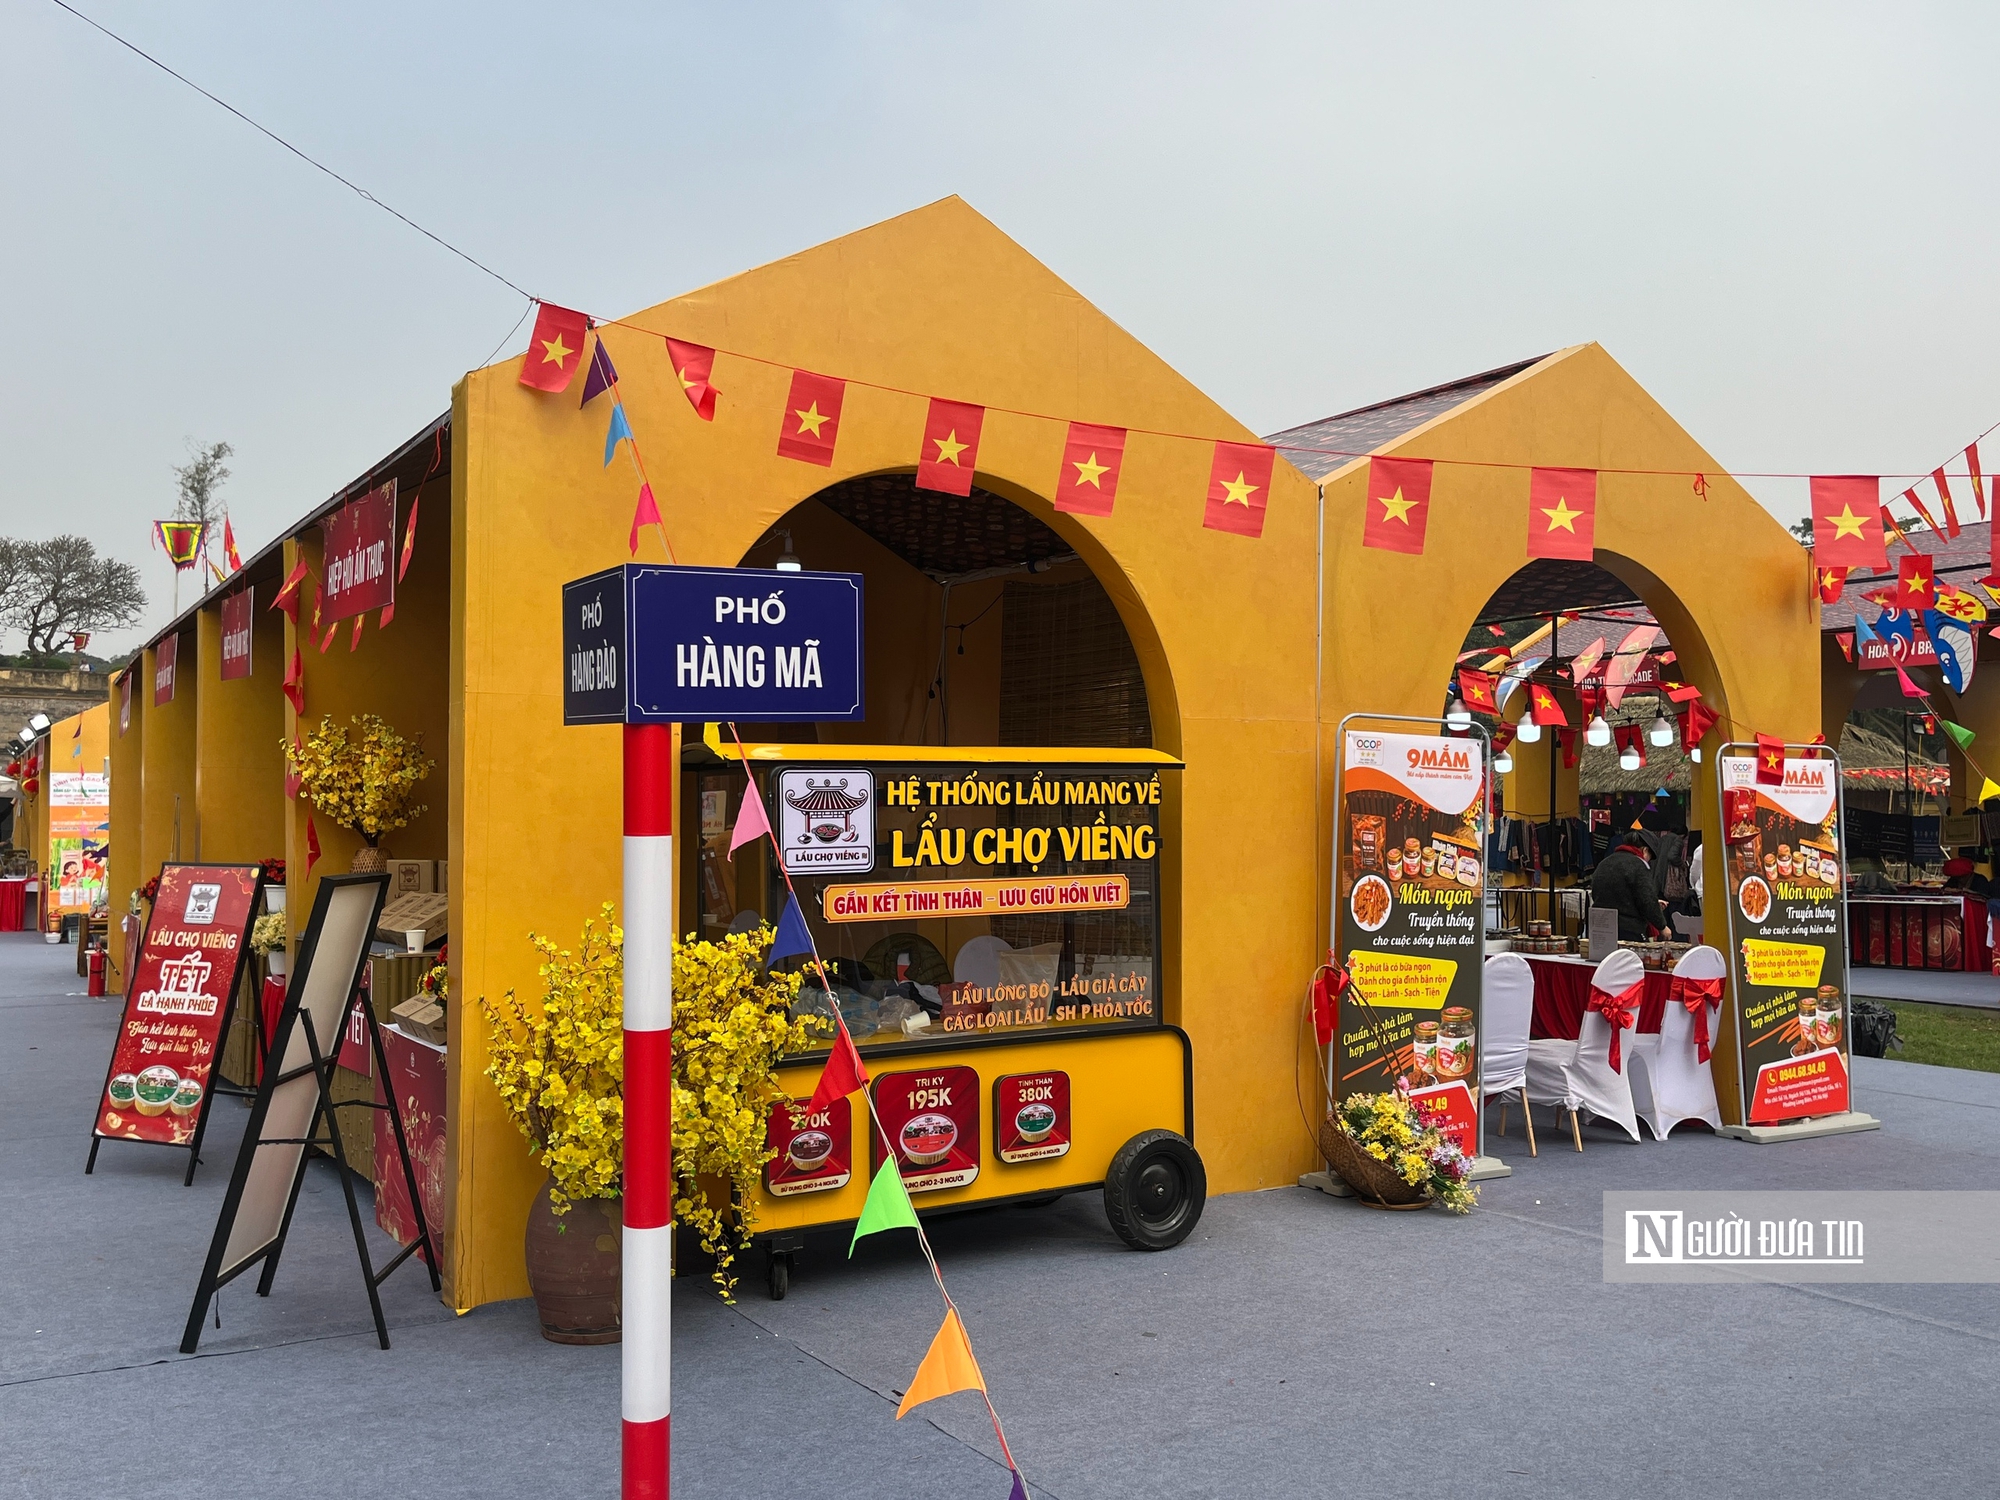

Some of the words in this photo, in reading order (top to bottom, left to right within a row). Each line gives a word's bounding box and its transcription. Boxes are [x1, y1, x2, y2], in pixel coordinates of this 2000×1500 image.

[581, 592, 603, 630] PHỐ
[715, 590, 786, 625] PHỐ
[571, 644, 595, 693] HÀNG
[596, 639, 617, 691] ĐÀO
[676, 635, 765, 688] HÀNG
[775, 639, 823, 688] MÃ
[1357, 739, 1381, 748] OCOP
[1407, 744, 1469, 768] 9MẮM
[887, 775, 921, 812] HỆ
[926, 770, 1010, 805] THỐNG
[1015, 770, 1060, 805] LẨU
[1064, 781, 1131, 805] MANG
[1134, 772, 1161, 805] VỀ
[892, 811, 967, 867] LẨU
[973, 827, 1051, 872] CHỢ
[1056, 810, 1156, 862] VIỀNG
[814, 852, 833, 863] CHỢ
[834, 889, 868, 914] GẮN
[873, 888, 899, 912] KẾT
[904, 893, 938, 911] TÌNH
[943, 887, 982, 909] THÂN
[1000, 888, 1026, 907] LƯU
[1031, 884, 1055, 905] GIỮ
[1059, 882, 1090, 904] HỒN
[1094, 881, 1121, 905] VIỆT
[1399, 883, 1431, 904] Món
[1434, 889, 1473, 910] ngon
[1777, 882, 1804, 900] Món
[1806, 887, 1834, 904] ngon
[1408, 911, 1444, 931] Truyền
[1446, 911, 1475, 931] thống
[1815, 904, 1836, 922] thống
[150, 925, 173, 946] LẨU
[174, 930, 200, 949] CHỢ
[202, 928, 237, 950] VIỀNG
[1373, 936, 1390, 946] cho
[1391, 937, 1411, 948] cuộc
[1413, 933, 1435, 948] sống
[1437, 935, 1457, 946] hiện
[1459, 935, 1475, 946] đại
[1760, 926, 1772, 934] cho
[1791, 924, 1808, 936] sống
[1824, 924, 1837, 934] đại
[1752, 949, 1756, 957] 3
[161, 951, 211, 993] TẾT
[1359, 963, 1364, 972] 3
[1366, 962, 1381, 974] phút
[1383, 962, 1389, 972] là
[1391, 963, 1398, 972] có
[1400, 963, 1412, 972] bữa
[1414, 964, 1431, 974] ngon
[953, 982, 984, 1006] LẨU
[1061, 974, 1089, 996] LẨU
[1359, 976, 1376, 986] Dành
[1378, 976, 1391, 984] cho
[1393, 976, 1402, 986] gia
[1404, 975, 1419, 984] đình
[1421, 974, 1434, 986] bận
[1436, 975, 1447, 986] rộn
[1382, 988, 1399, 998] Lành
[1404, 987, 1420, 999] Sạch
[1425, 987, 1440, 998] Tiện
[351, 1002, 365, 1046] TẾT
[944, 1011, 976, 1032] CÁC
[977, 1011, 1013, 1033] LOẠI
[1015, 1001, 1046, 1025] LẨU
[1125, 994, 1152, 1016] TỐC
[1397, 1012, 1414, 1026] làm
[907, 1087, 952, 1110] 195K
[1018, 1086, 1053, 1102] 380K
